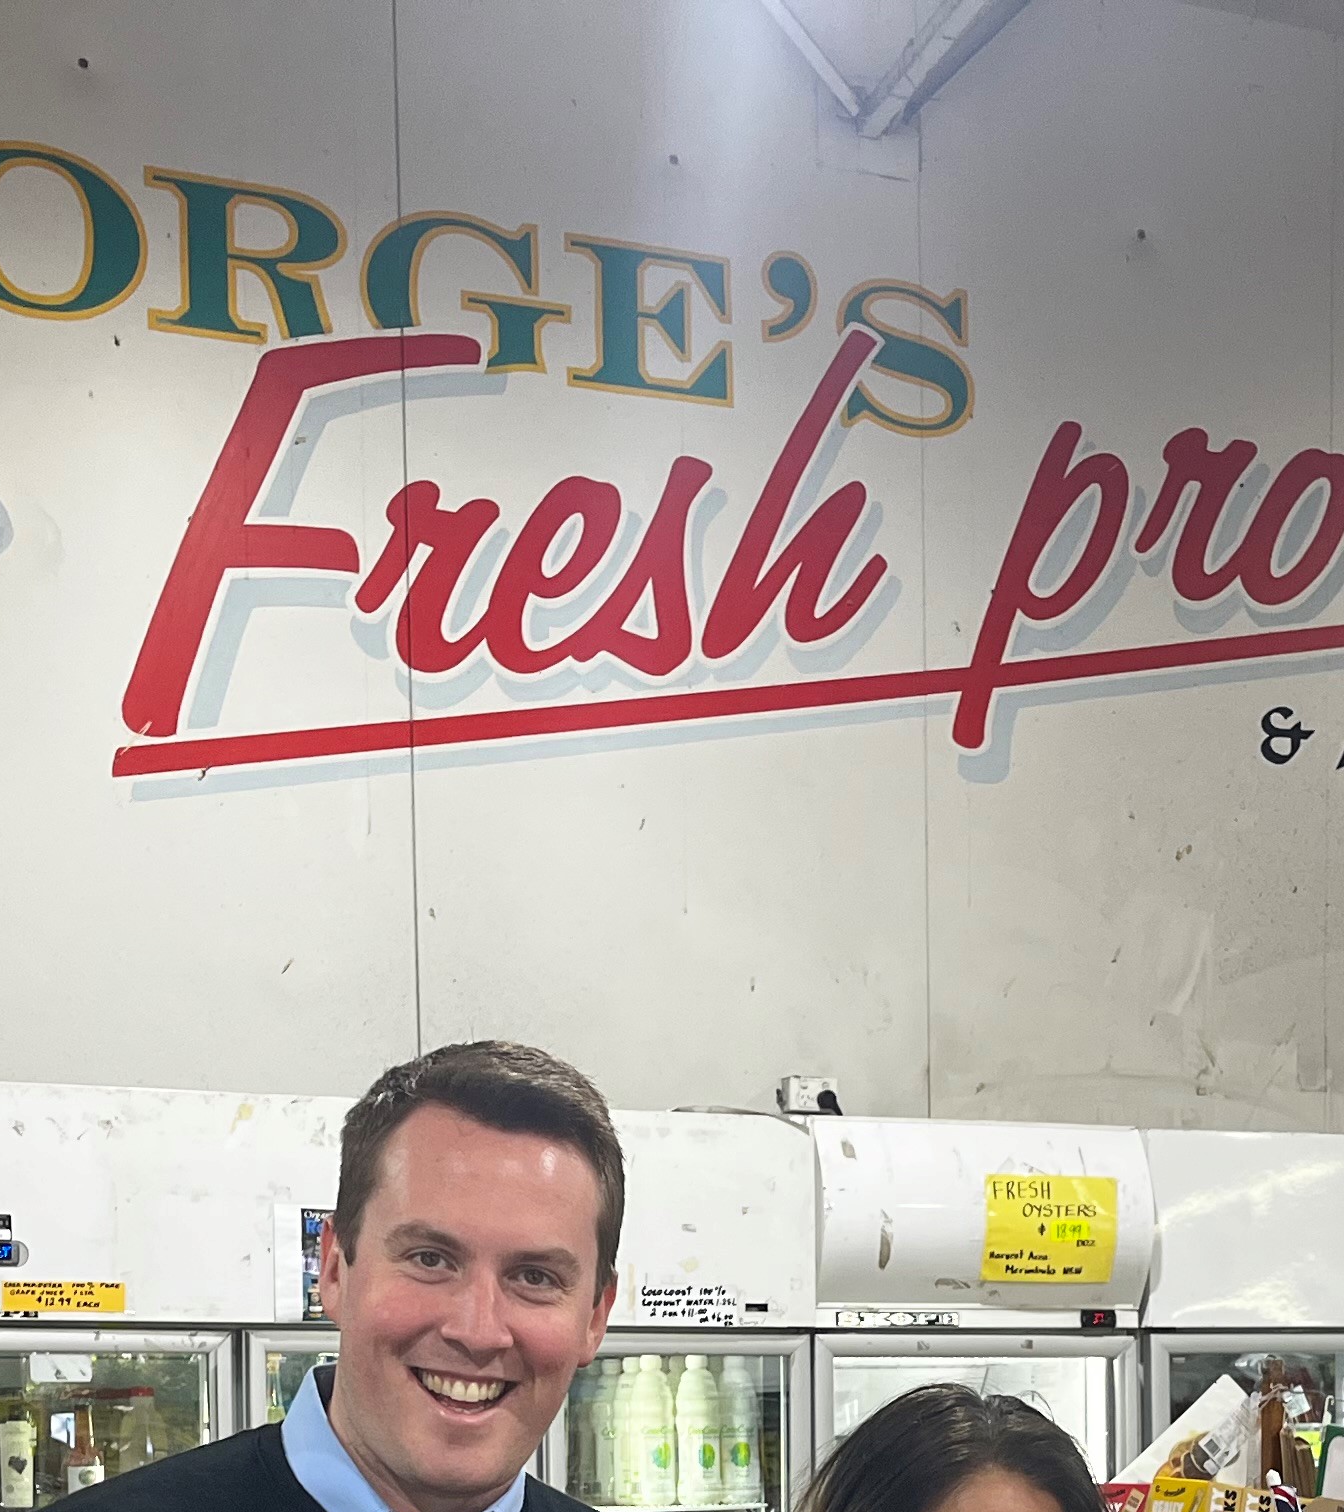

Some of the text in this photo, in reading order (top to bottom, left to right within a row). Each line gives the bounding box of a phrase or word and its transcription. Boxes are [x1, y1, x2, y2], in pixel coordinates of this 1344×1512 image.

[122, 322, 890, 738] Fresh
[1260, 706, 1315, 766] &
[992, 1180, 1051, 1200] FRESH
[1022, 1202, 1097, 1218] OYSTERS
